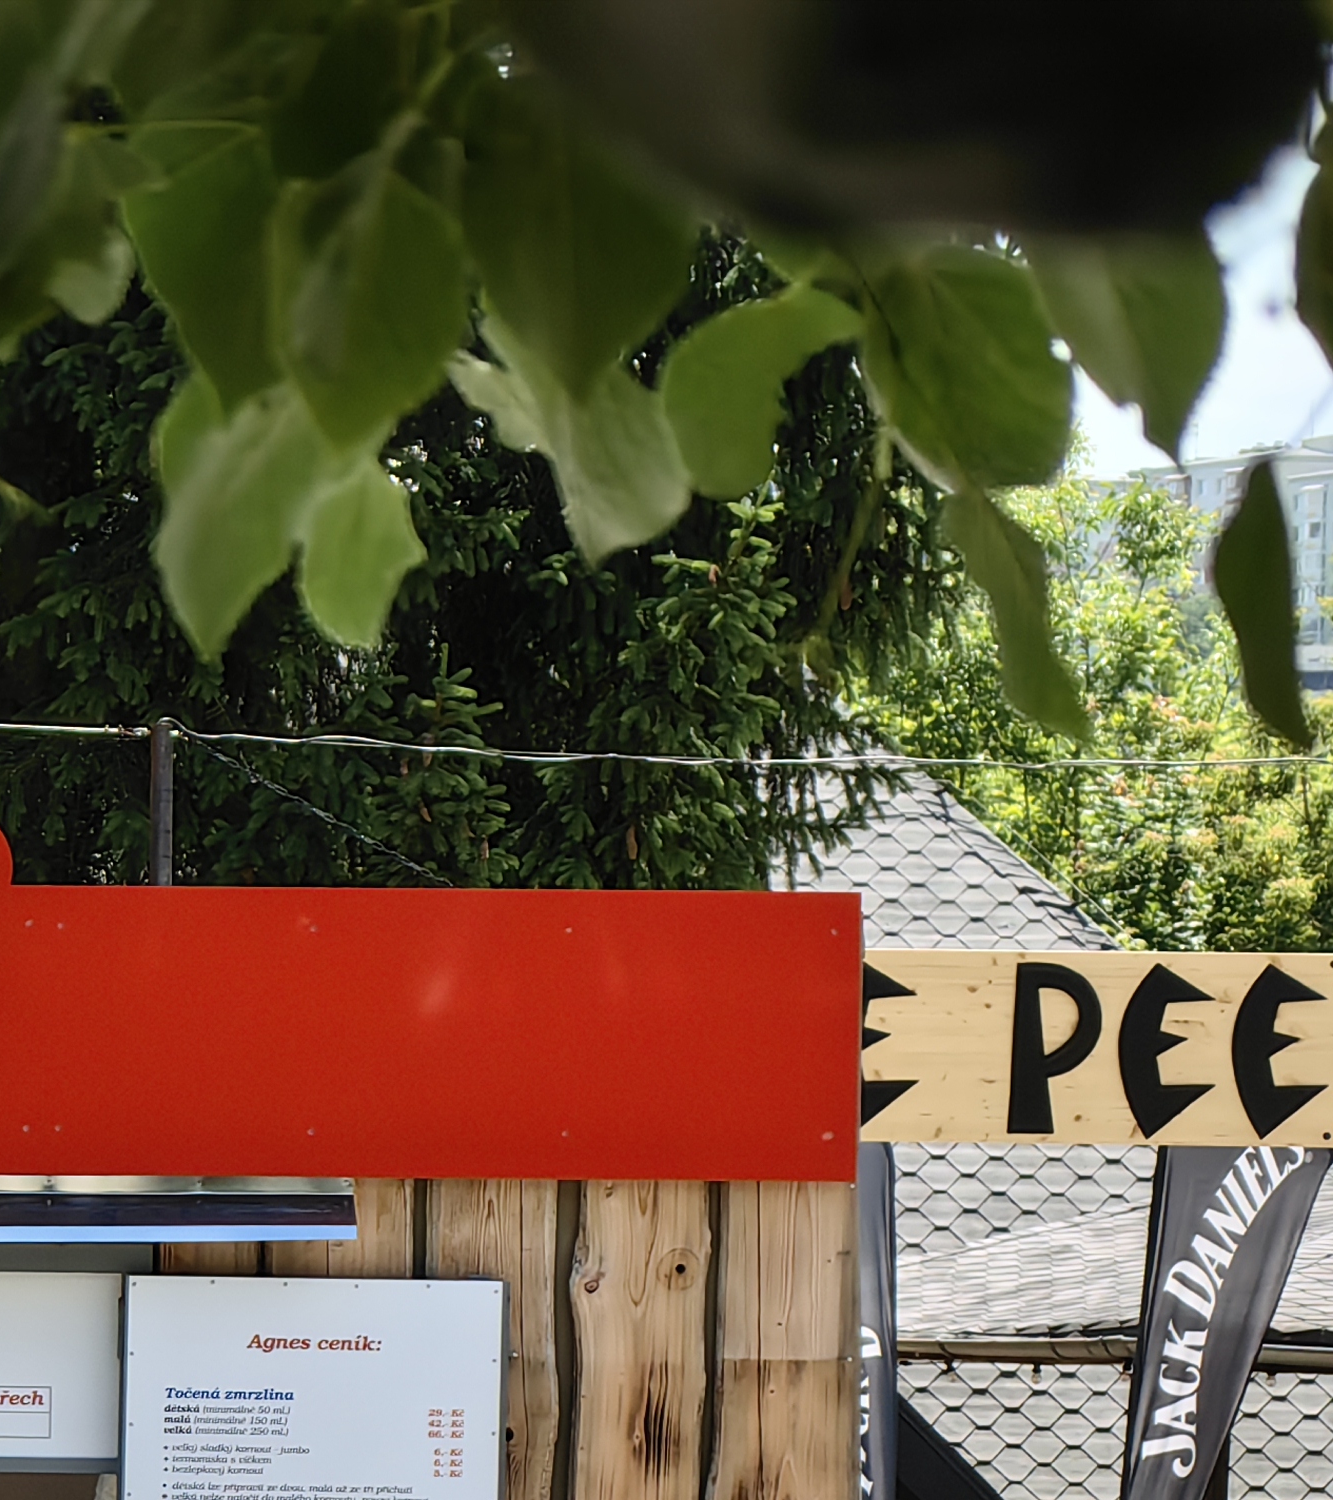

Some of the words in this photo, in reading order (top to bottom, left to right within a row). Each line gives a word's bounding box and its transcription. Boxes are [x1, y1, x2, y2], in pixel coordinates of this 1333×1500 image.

[1007, 962, 1329, 1140] PEE
[247, 1334, 311, 1353] Agnes
[317, 1336, 382, 1351] ceník:
[165, 1387, 221, 1400] Točená
[225, 1388, 294, 1401] zmrzlina
[1142, 1319, 1209, 1478] JACK
[164, 1415, 191, 1423] malá
[164, 1426, 192, 1434] velká
